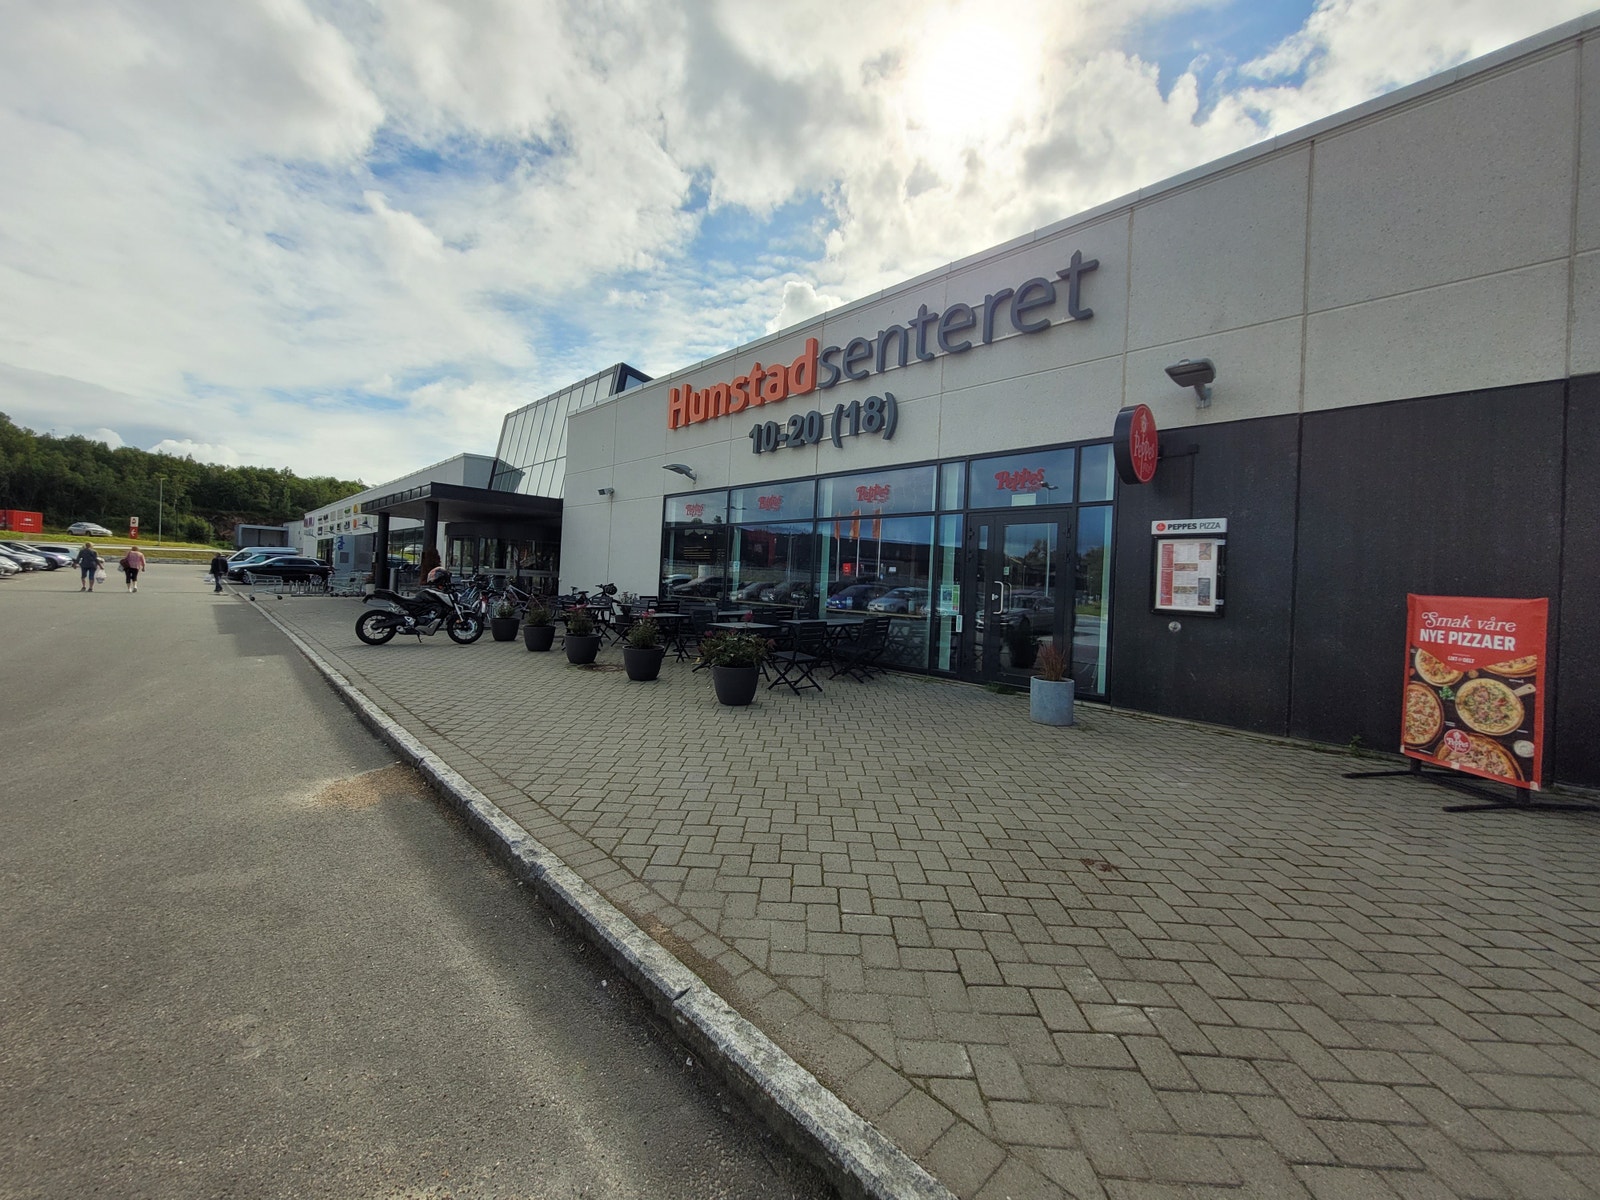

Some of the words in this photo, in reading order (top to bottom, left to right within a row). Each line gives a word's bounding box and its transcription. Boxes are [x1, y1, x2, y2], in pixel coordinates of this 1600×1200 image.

[668, 249, 1100, 431] Hunstadsenteret
[749, 410, 824, 454] 10-20
[831, 392, 898, 448] (18)
[1134, 430, 1155, 461] Peppes
[1422, 611, 1473, 628] Smak
[1477, 616, 1517, 633] våre
[1420, 628, 1445, 644] NYE
[1448, 631, 1517, 652] PIZZAER
